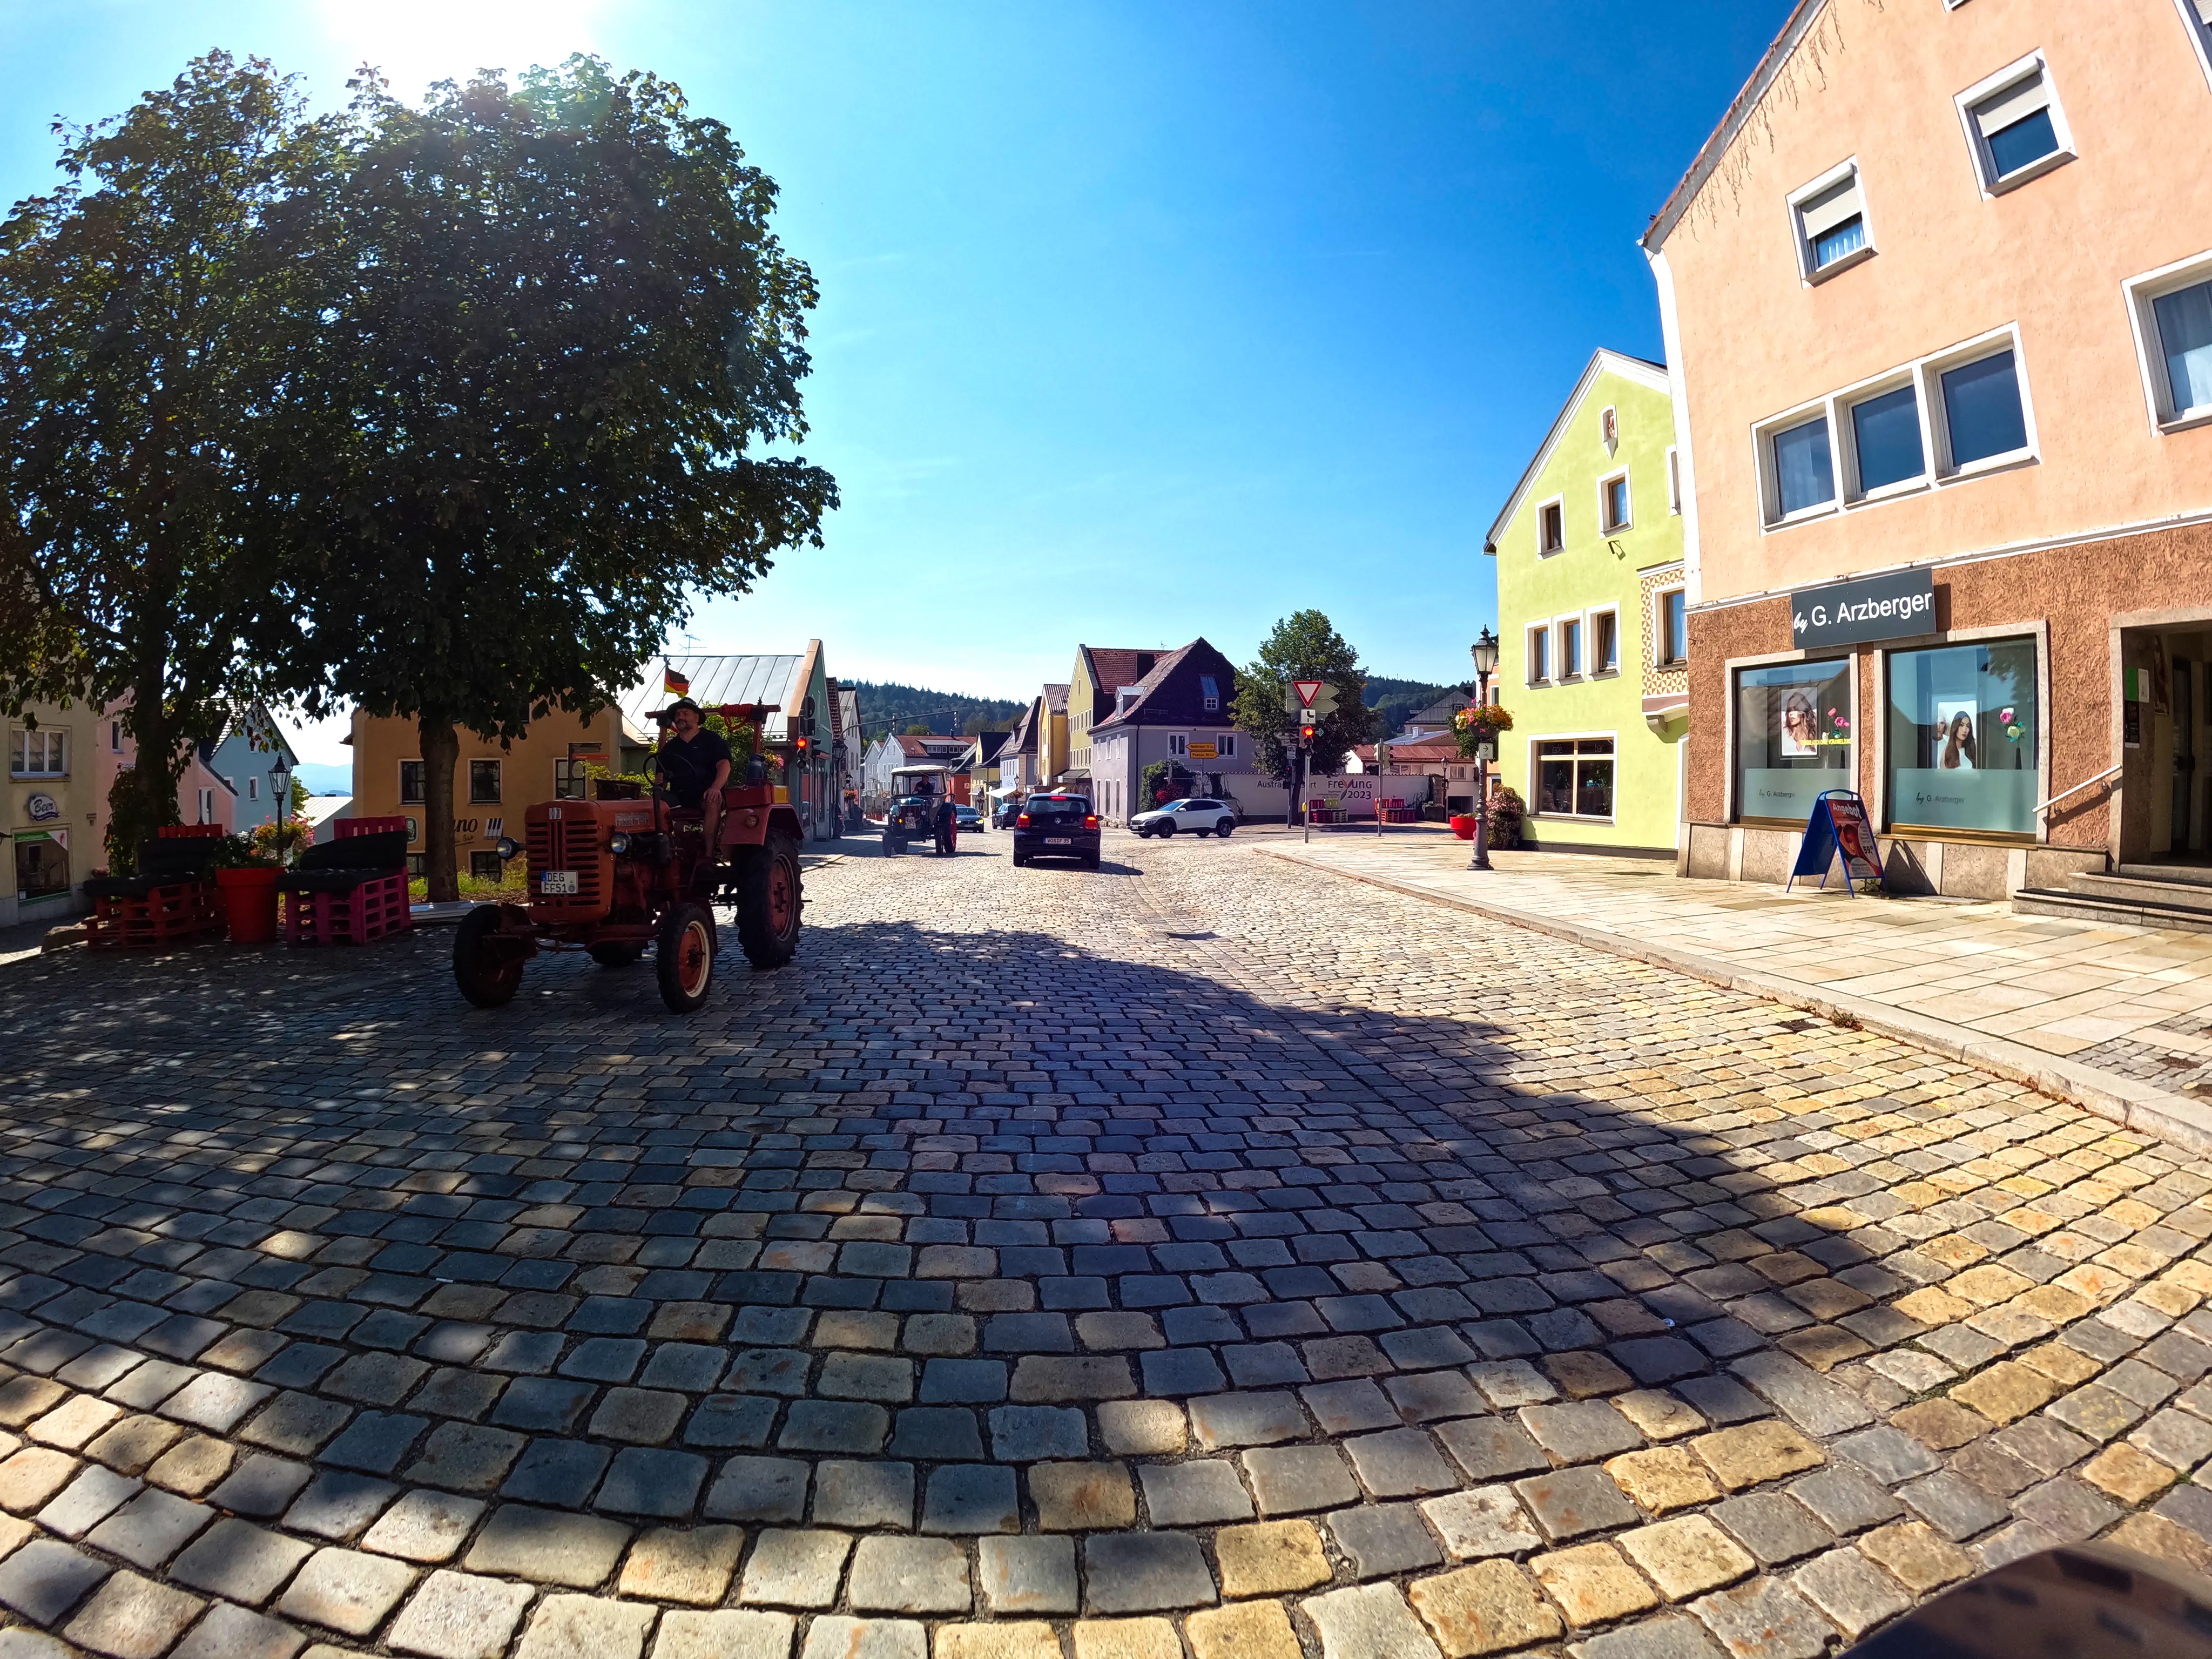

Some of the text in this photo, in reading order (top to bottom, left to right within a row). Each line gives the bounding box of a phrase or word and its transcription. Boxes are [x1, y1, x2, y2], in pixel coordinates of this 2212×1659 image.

[1793, 592, 1932, 634] by G. Arzberger
[1595, 743, 1603, 753] bar
[1347, 791, 1372, 800] 2023
[1832, 804, 1862, 819] Angebot
[548, 873, 564, 882] DEG
